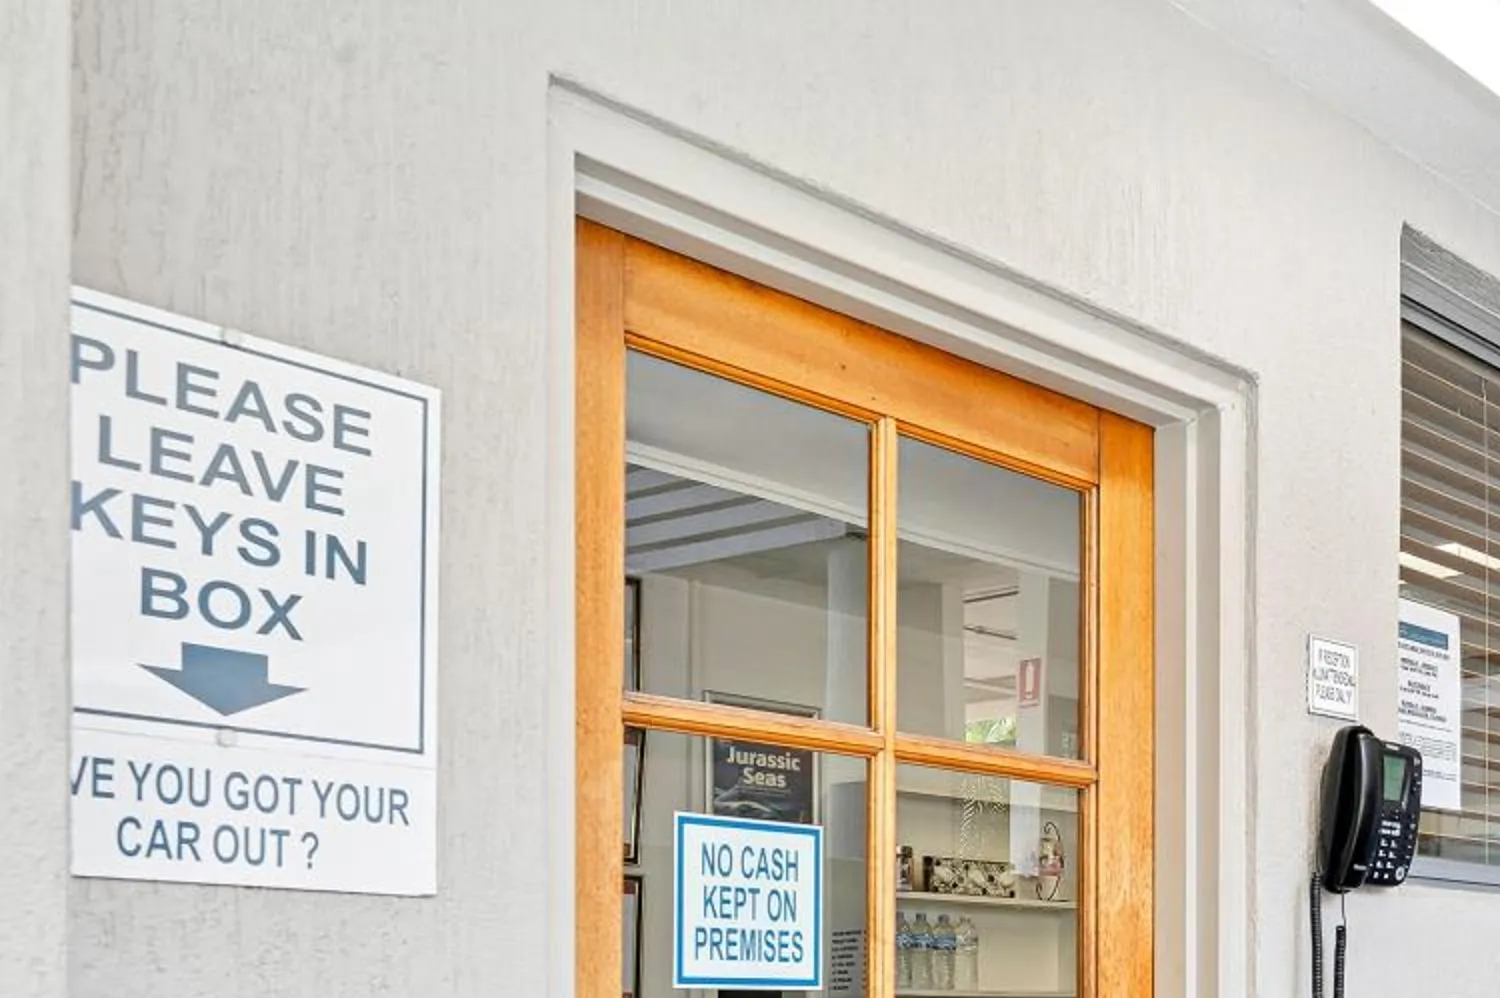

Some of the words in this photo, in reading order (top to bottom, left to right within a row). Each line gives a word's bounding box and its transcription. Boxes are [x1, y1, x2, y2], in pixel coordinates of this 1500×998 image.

[71, 333, 372, 457] PLEASE
[98, 414, 345, 517] LEAVE
[71, 479, 281, 567] KEYS
[304, 530, 367, 585] IN
[140, 567, 303, 641] BOX
[726, 747, 801, 772] Jurassic
[743, 767, 788, 789] Seas
[127, 760, 211, 808] YOU
[224, 770, 302, 816] GOT
[311, 780, 410, 827] YOUR
[117, 816, 202, 862] CAR
[213, 824, 291, 868] OUT
[301, 831, 319, 869] ?
[701, 842, 734, 877] NO
[740, 845, 799, 882] CASH
[703, 886, 760, 920] KEPT
[767, 890, 797, 923] ON
[695, 927, 804, 964] PREMISES
